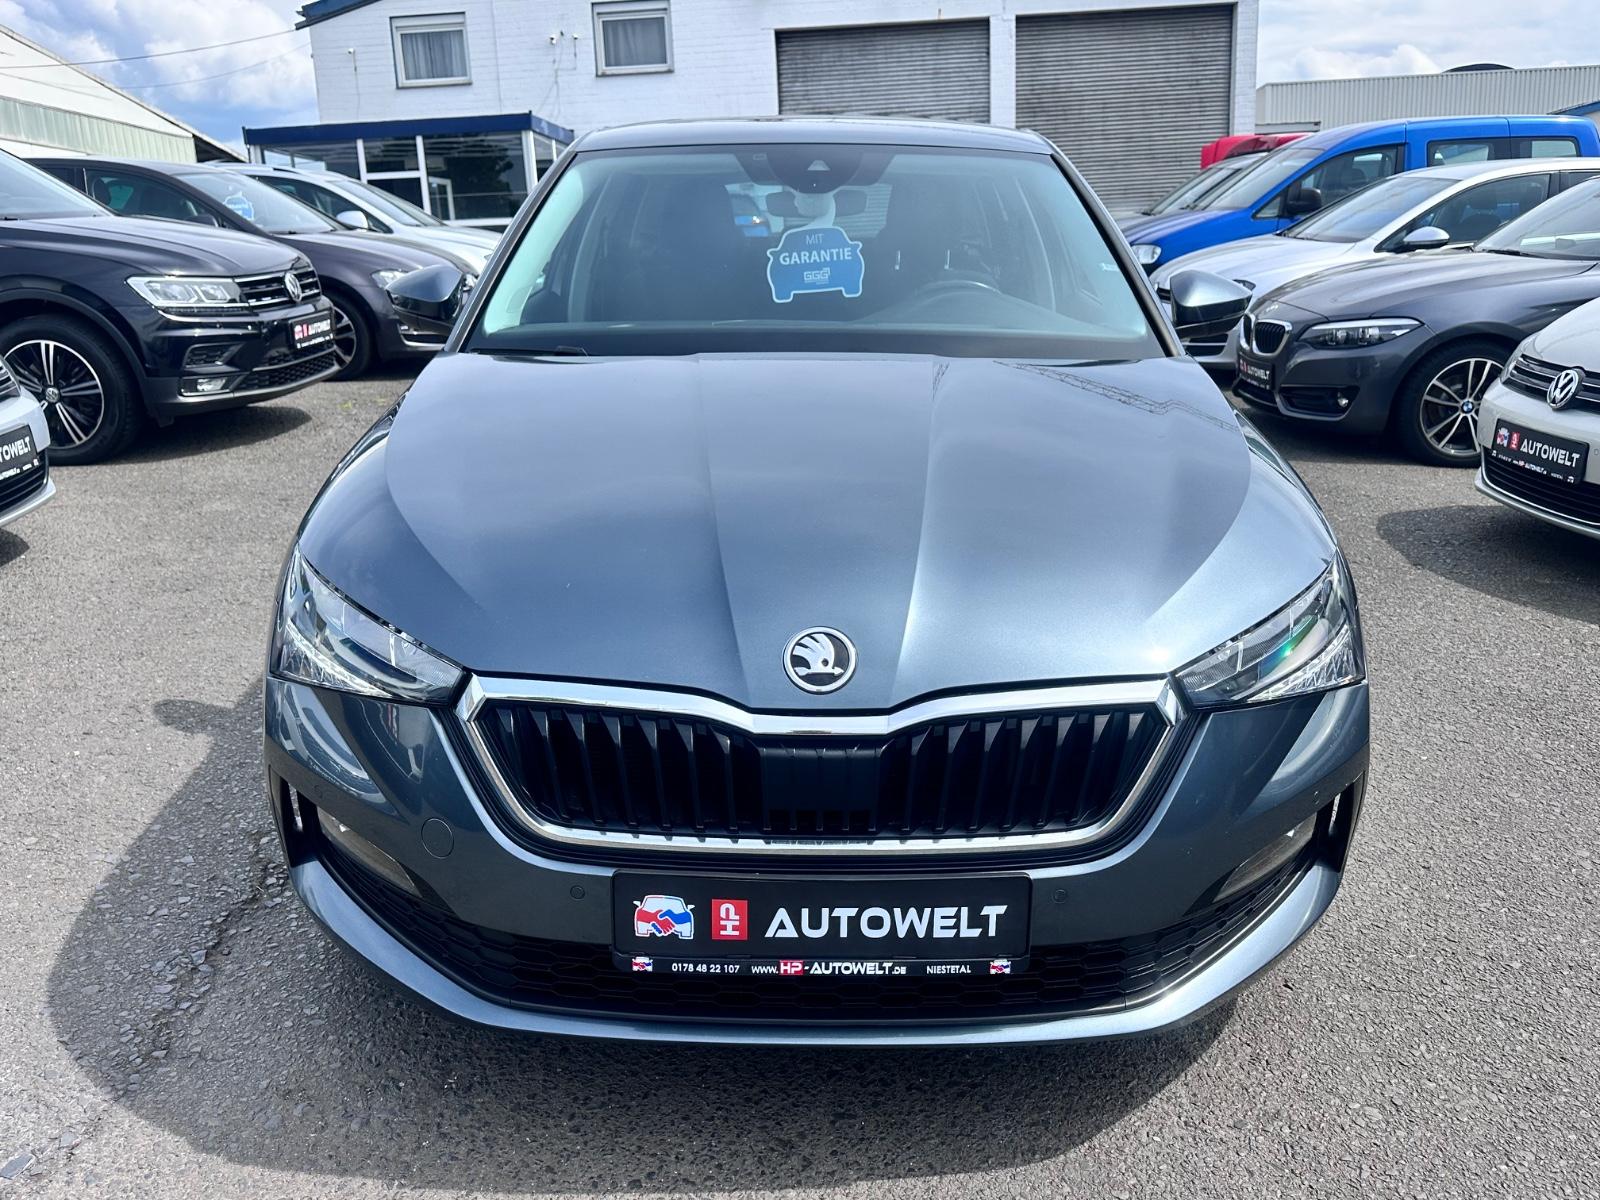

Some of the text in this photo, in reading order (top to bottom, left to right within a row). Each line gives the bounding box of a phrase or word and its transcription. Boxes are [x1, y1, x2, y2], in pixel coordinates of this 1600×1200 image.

[806, 233, 825, 245] MIT
[780, 247, 852, 265] GARANTIE
[803, 269, 829, 281] GGG
[1520, 438, 1580, 468] AUTOWELT
[719, 903, 1008, 939] HP AUTOWELT
[672, 962, 694, 973] 0178
[696, 963, 708, 973] 48
[709, 964, 721, 973] 22
[723, 964, 740, 973] 107
[926, 965, 972, 975] NIESTETAL
